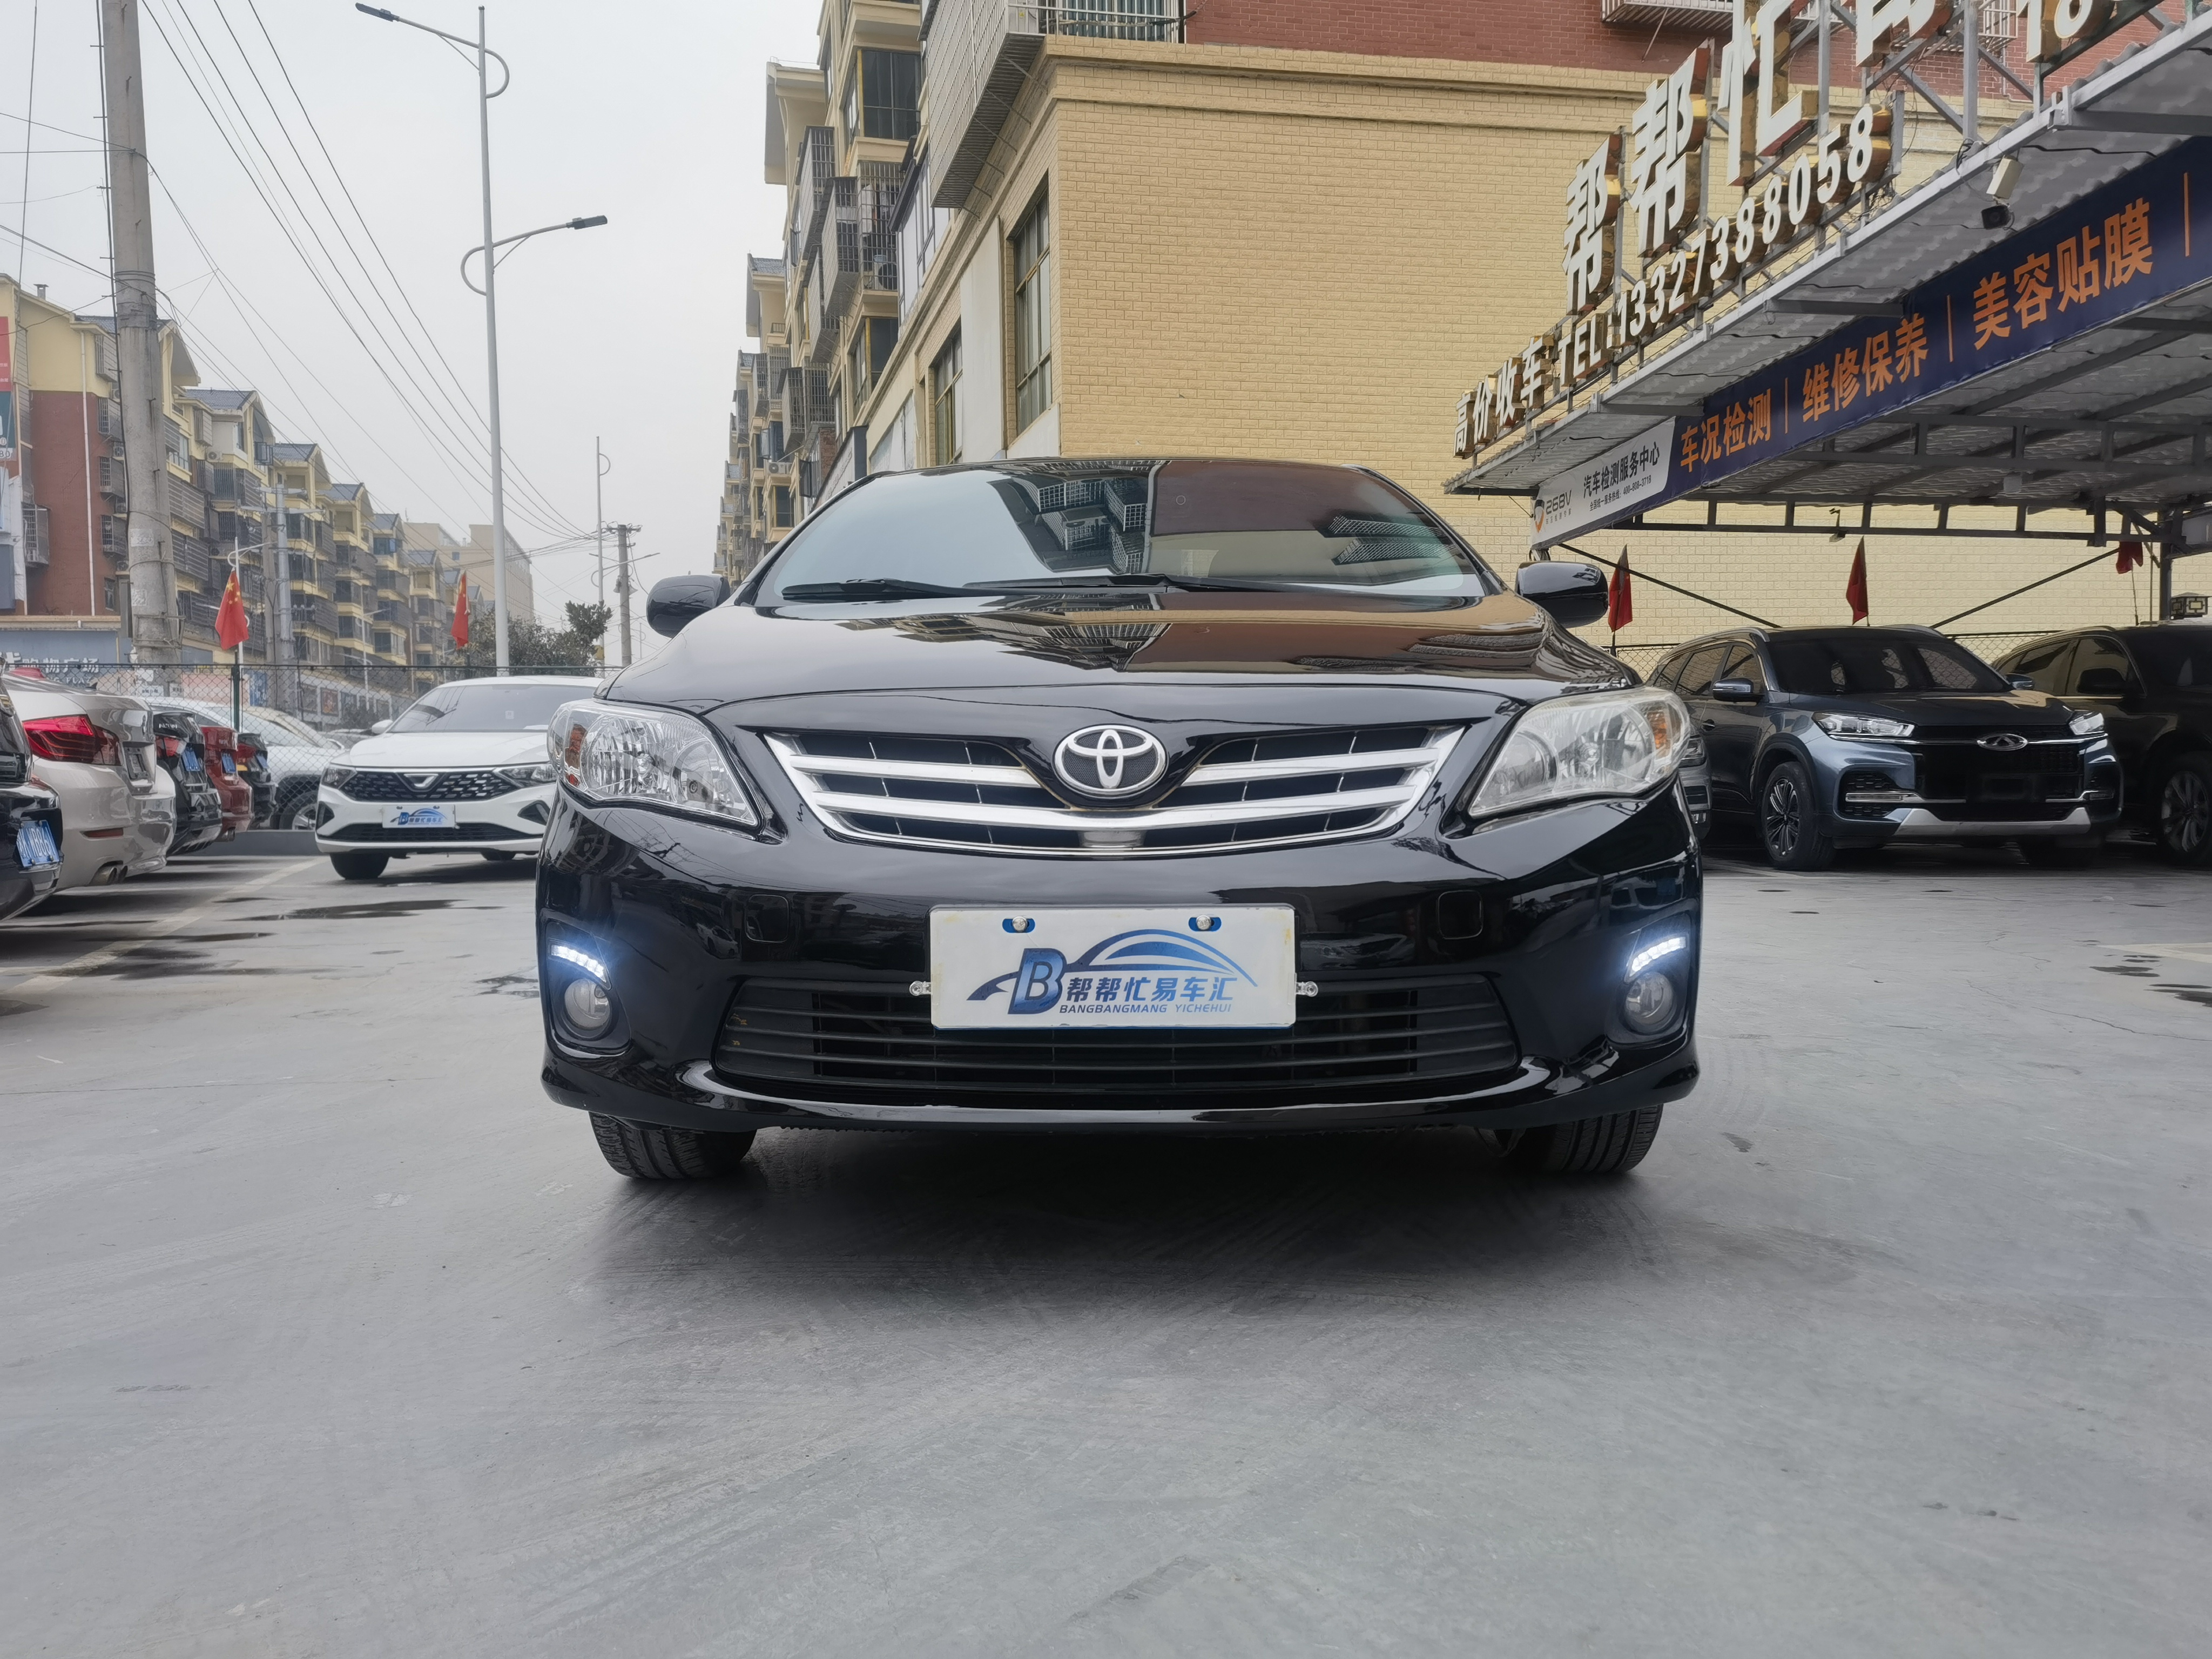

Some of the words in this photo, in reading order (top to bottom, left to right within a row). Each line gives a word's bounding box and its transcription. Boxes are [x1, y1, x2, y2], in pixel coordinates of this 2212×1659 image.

[1562, 0, 1935, 316] 帮帮忙
[1680, 388, 1771, 473] 车况检测
[1802, 313, 1929, 422] 维修保养
[1973, 197, 2153, 346] 美容贴膜
[1453, 336, 1543, 459] 高价收车
[1583, 441, 1660, 499] 汽车检测服务中心
[1546, 490, 1572, 515] 268V
[1059, 1004, 1168, 1014] BANGBANGMANG
[1175, 1003, 1232, 1013] YICHEHUI
[1066, 976, 1238, 1002] 帮帮忙易车汇
